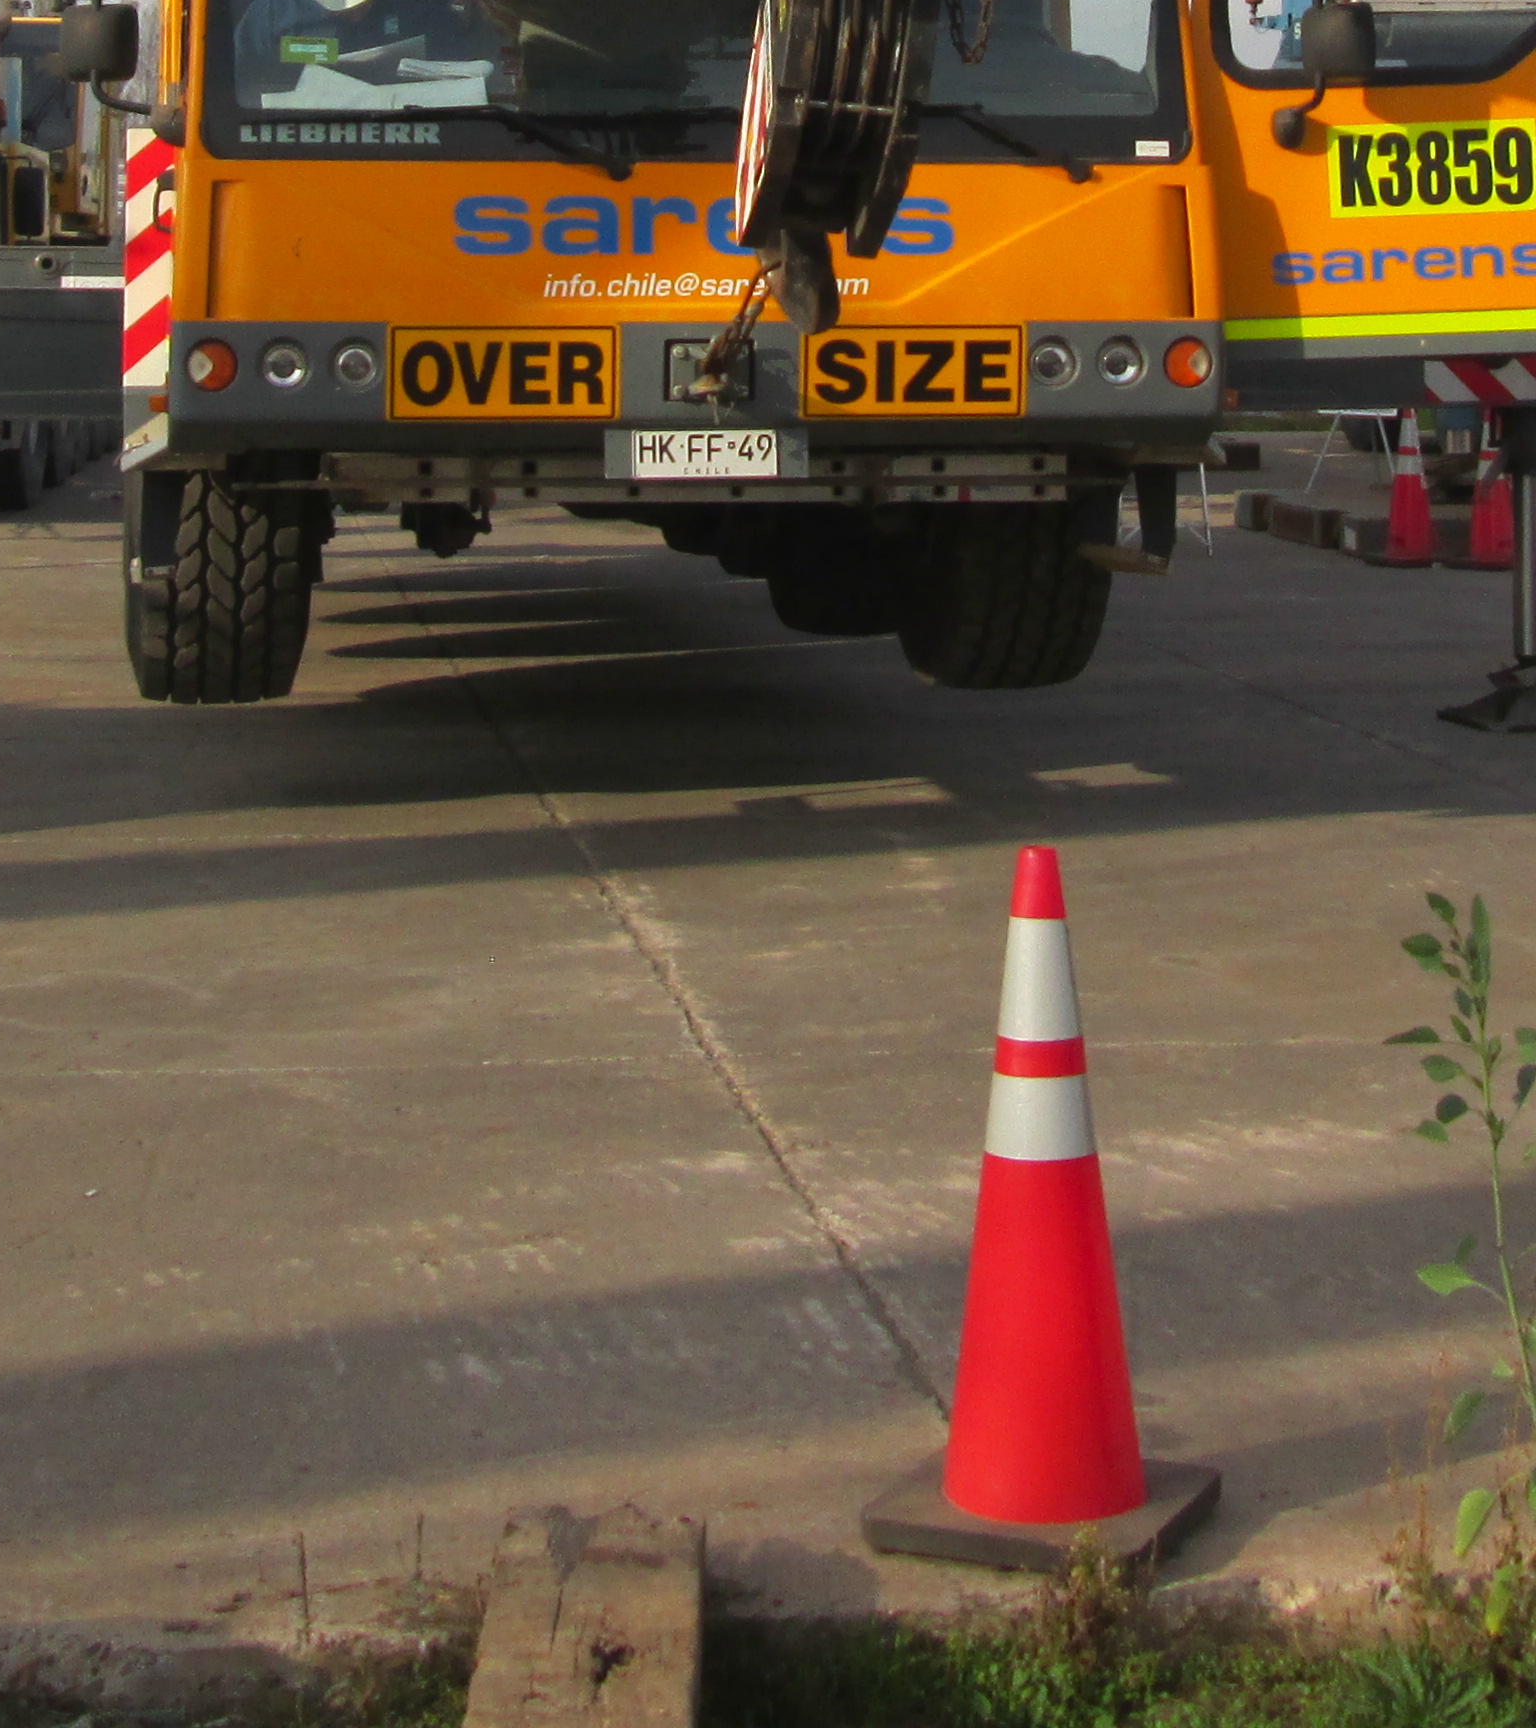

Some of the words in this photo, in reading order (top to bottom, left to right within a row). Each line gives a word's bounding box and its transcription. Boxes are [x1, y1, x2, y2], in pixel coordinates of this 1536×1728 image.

[239, 123, 441, 144] LIEBHERR
[1337, 126, 1534, 208] K3859
[452, 195, 954, 257] sars
[401, 339, 606, 407] OVER
[815, 338, 1013, 405] SIZE
[683, 466, 731, 475] CHILE
